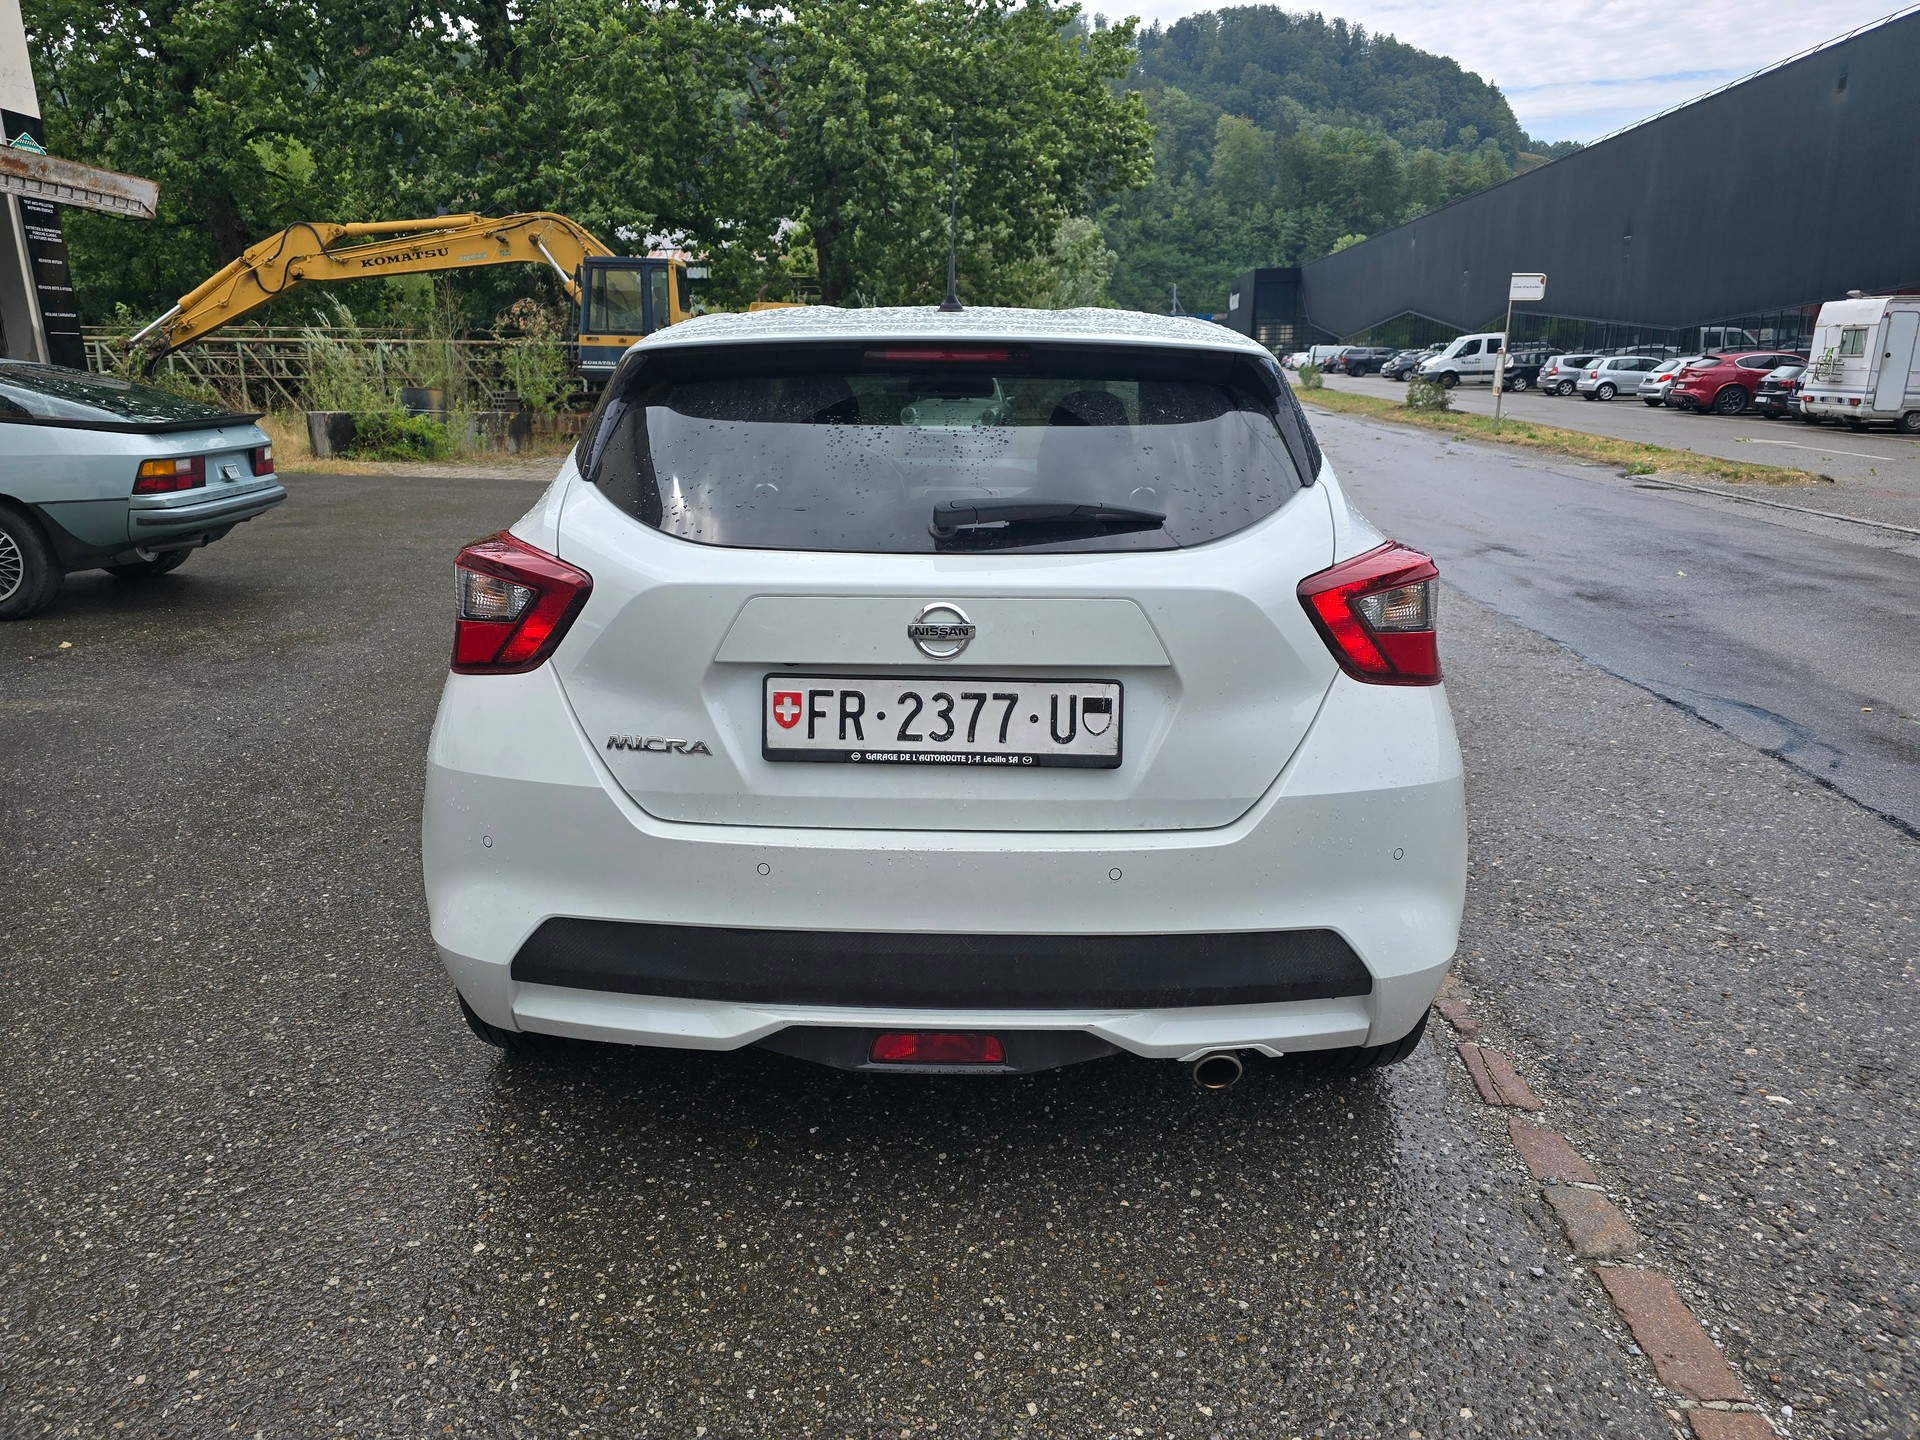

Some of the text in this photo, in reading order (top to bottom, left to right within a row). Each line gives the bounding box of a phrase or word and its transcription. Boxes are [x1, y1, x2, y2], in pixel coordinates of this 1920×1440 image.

[361, 247, 449, 268] KOMATSU
[914, 627, 969, 636] NISSAN
[606, 734, 713, 756] MICRA
[865, 753, 898, 761] GARAGE
[900, 753, 911, 761] DE
[912, 754, 966, 762] L'AUTOROUTE
[1008, 756, 1018, 764] SA
